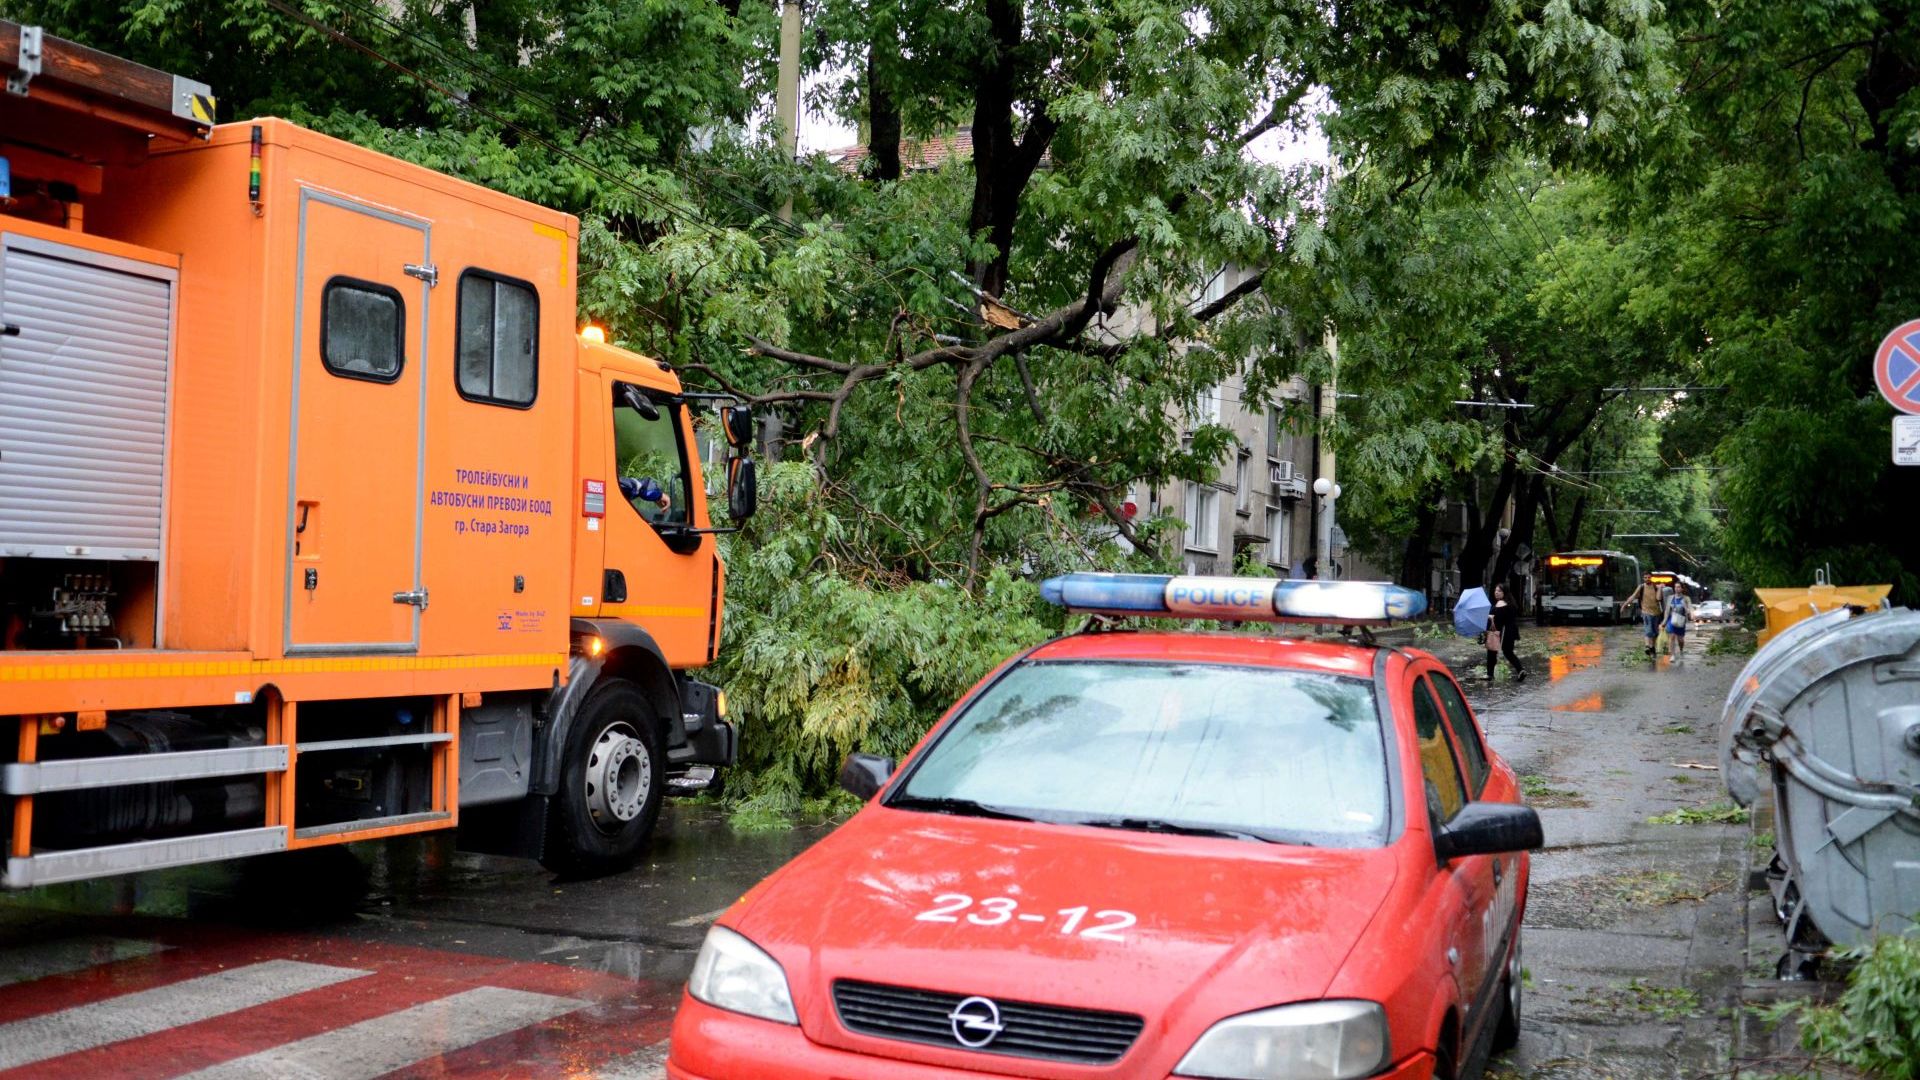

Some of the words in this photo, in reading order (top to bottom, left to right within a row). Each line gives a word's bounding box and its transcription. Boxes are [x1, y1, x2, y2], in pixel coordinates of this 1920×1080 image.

[456, 469, 520, 489] ТРОЛЕЙБУСНИ
[522, 476, 528, 489] И
[431, 491, 485, 509] АВТОБУСНИ
[487, 495, 527, 512] ПРЕВОЗИ
[529, 499, 552, 516] ЕООД
[455, 520, 468, 535] гр.
[470, 518, 497, 536] Стара
[499, 520, 529, 538] Загора
[1173, 587, 1264, 608] POLICE
[914, 893, 1137, 942] 23-12
